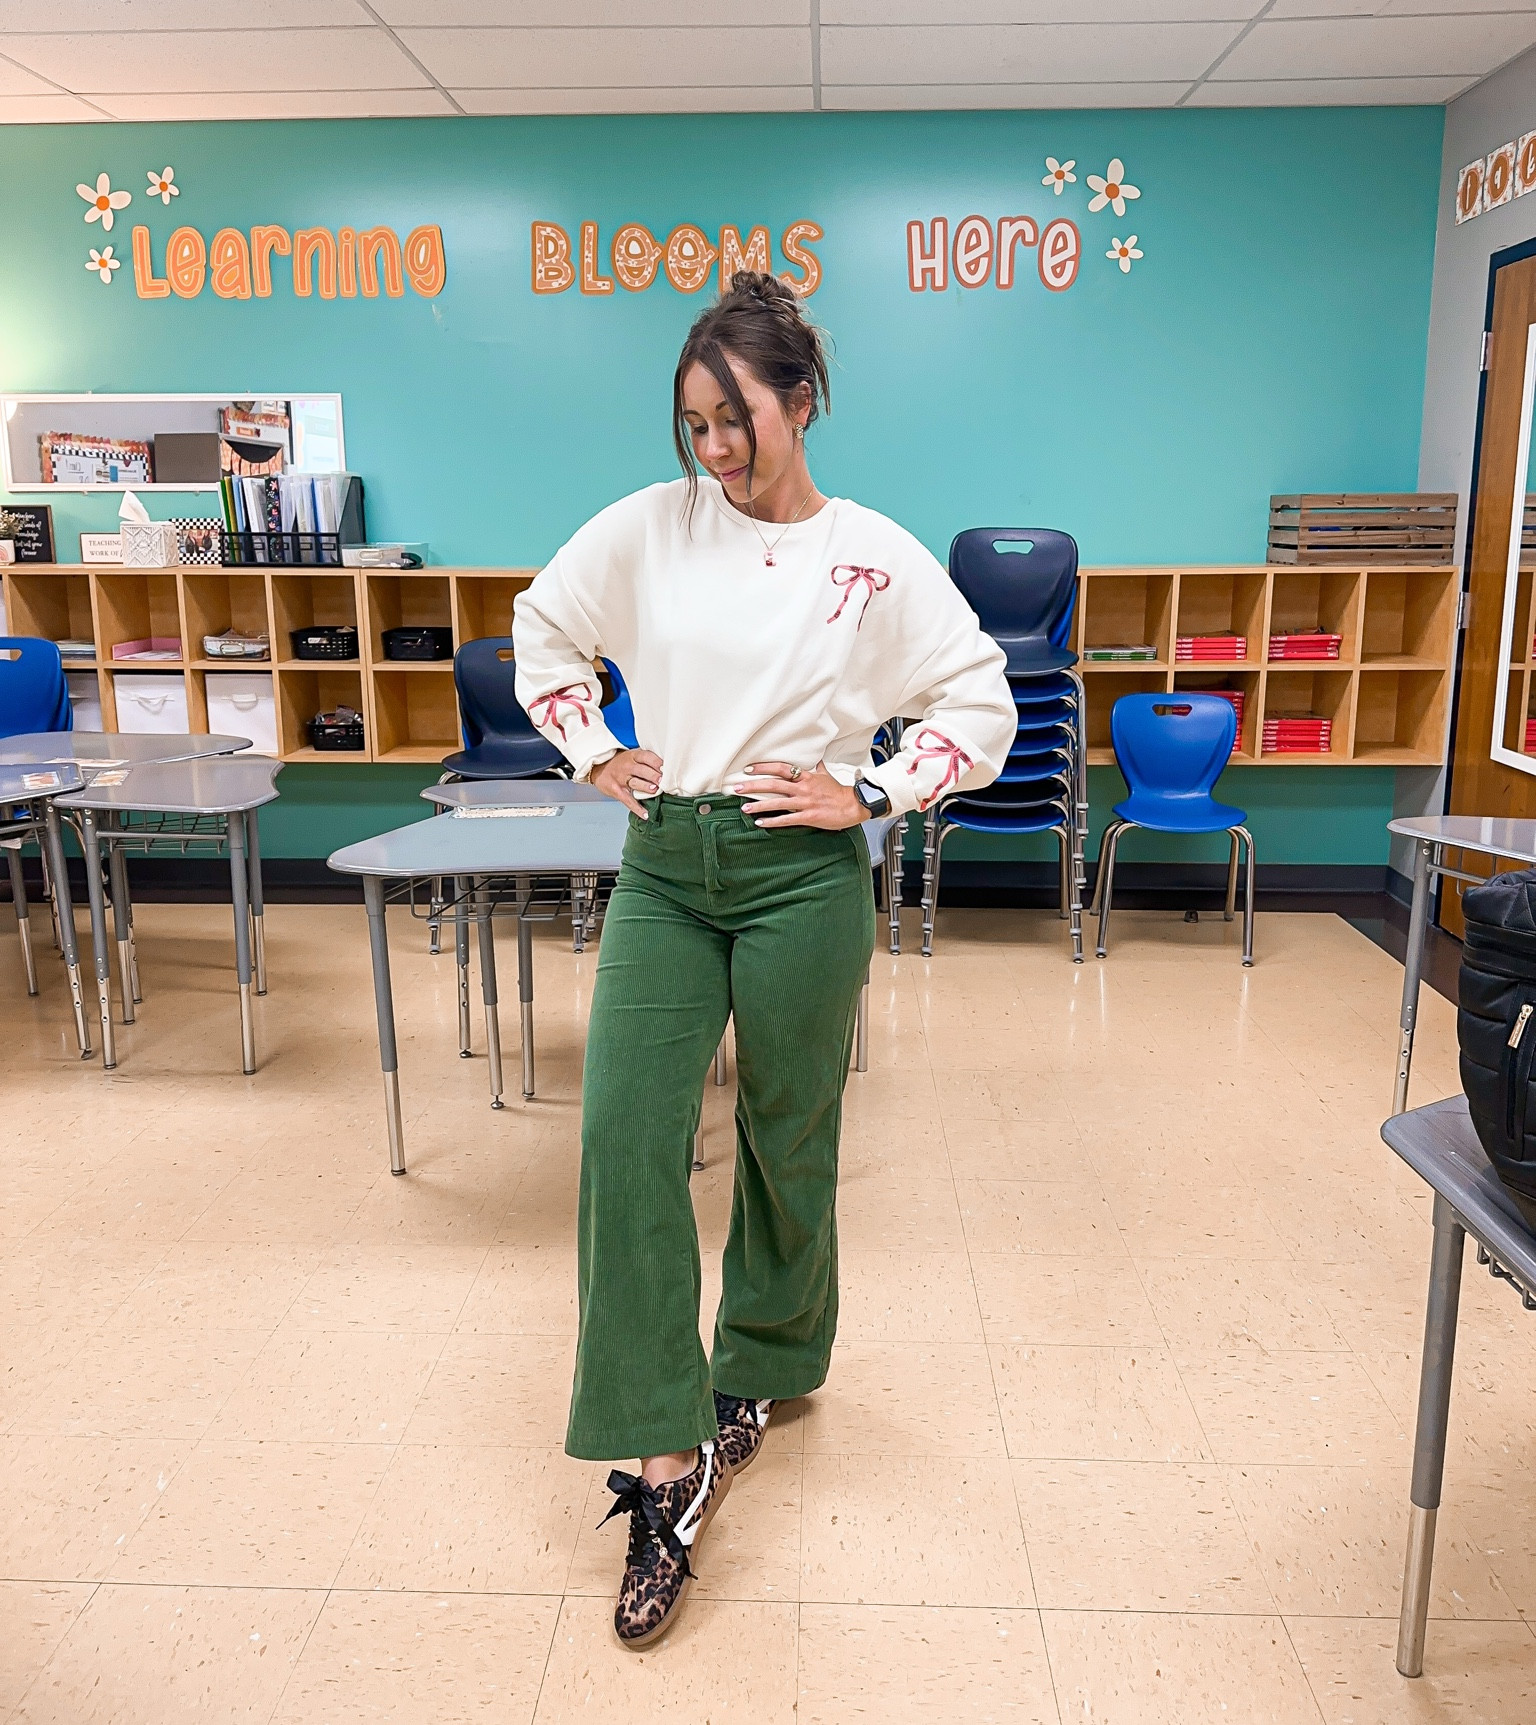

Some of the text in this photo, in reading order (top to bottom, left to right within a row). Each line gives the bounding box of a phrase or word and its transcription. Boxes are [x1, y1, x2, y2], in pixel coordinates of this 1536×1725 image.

[132, 214, 1081, 300] Learning BLOOMS Here
